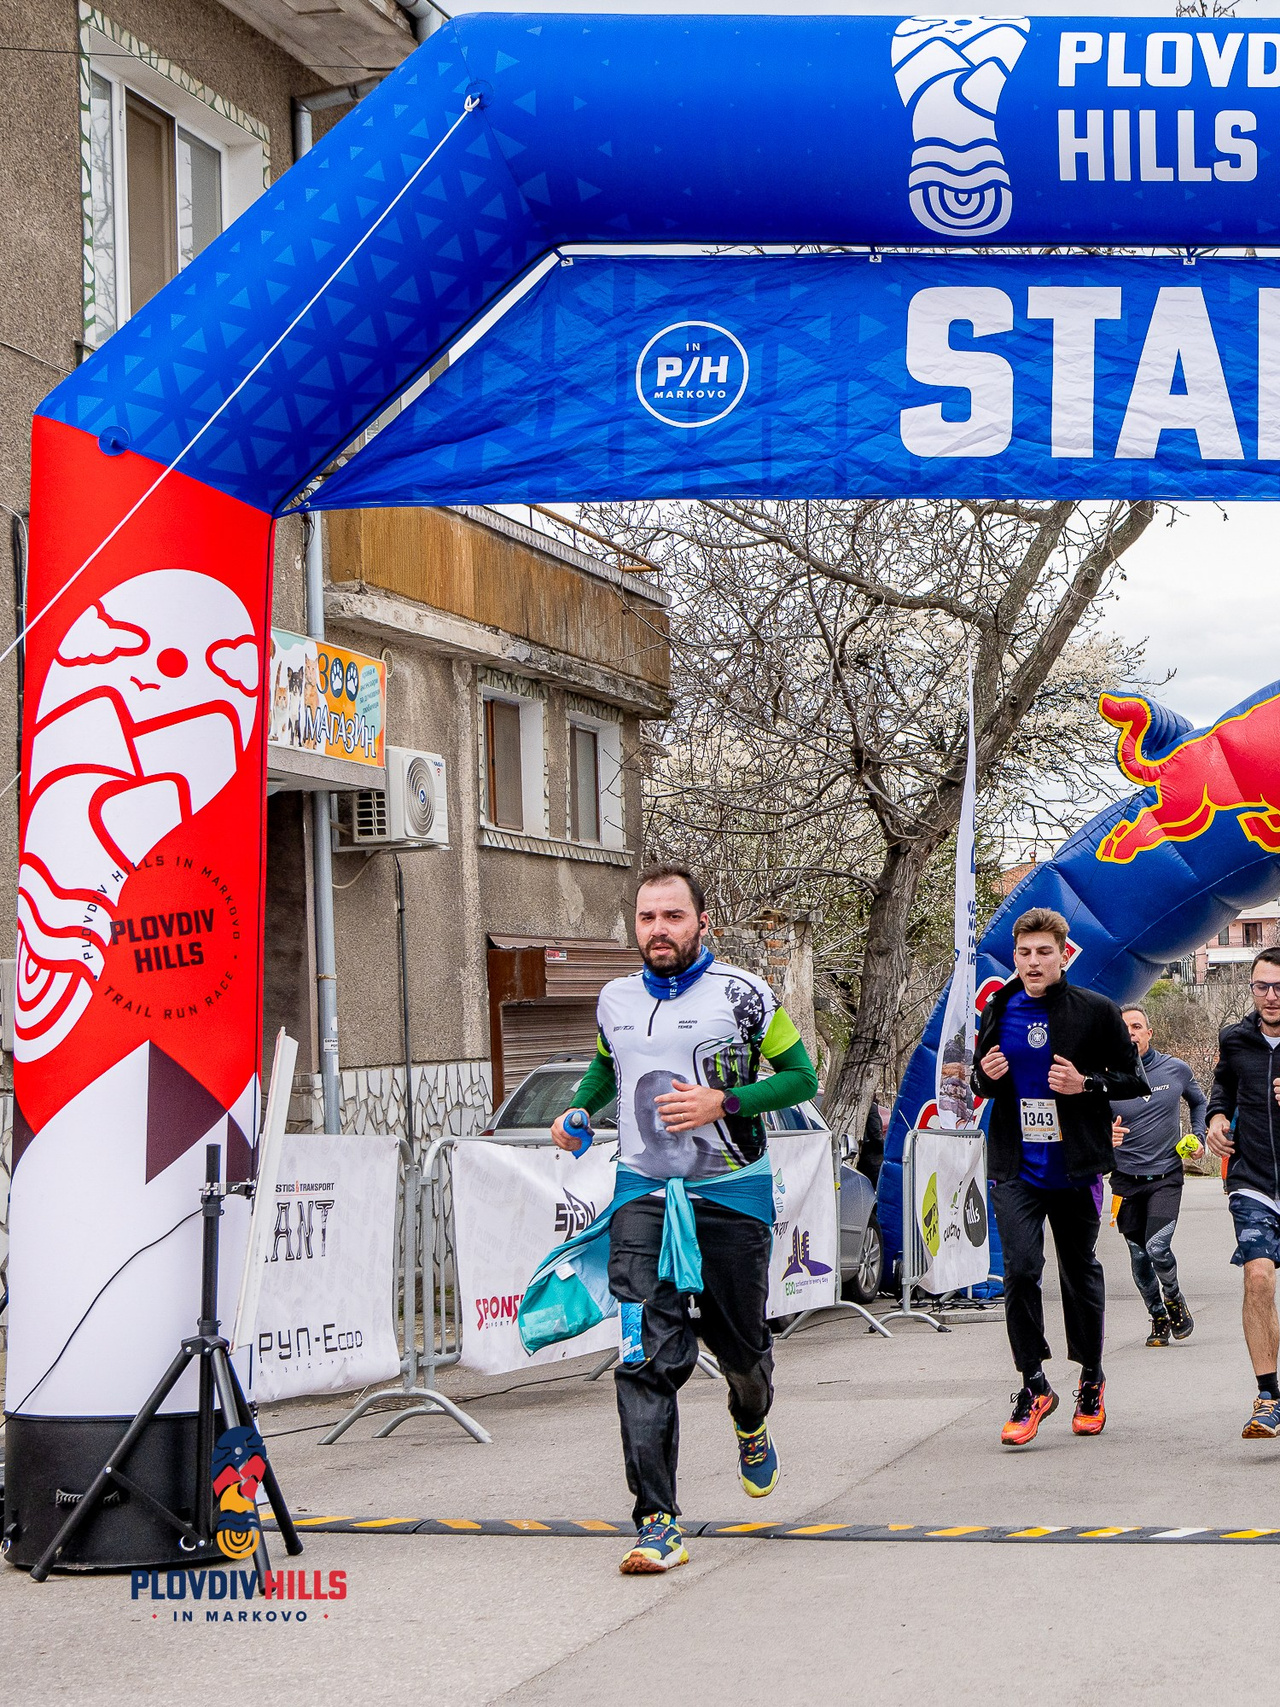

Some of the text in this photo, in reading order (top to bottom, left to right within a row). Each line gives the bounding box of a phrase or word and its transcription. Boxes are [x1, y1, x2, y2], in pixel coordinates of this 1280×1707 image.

[1058, 110, 1257, 181] HILLS
[685, 343, 700, 352] IN
[656, 355, 729, 387] P/H
[654, 390, 727, 399] MARKOVO
[305, 704, 377, 758] МАГАЗИН
[112, 856, 164, 882] HILLS
[176, 857, 193, 869] IN
[201, 867, 240, 940] MARKOVO
[110, 908, 214, 945] PLOVDIV
[134, 942, 204, 973] HILLS
[104, 971, 233, 1019] TRAIL RUN RACE
[1023, 1112, 1054, 1126] 1343
[300, 1178, 335, 1191] TRANSPORT
